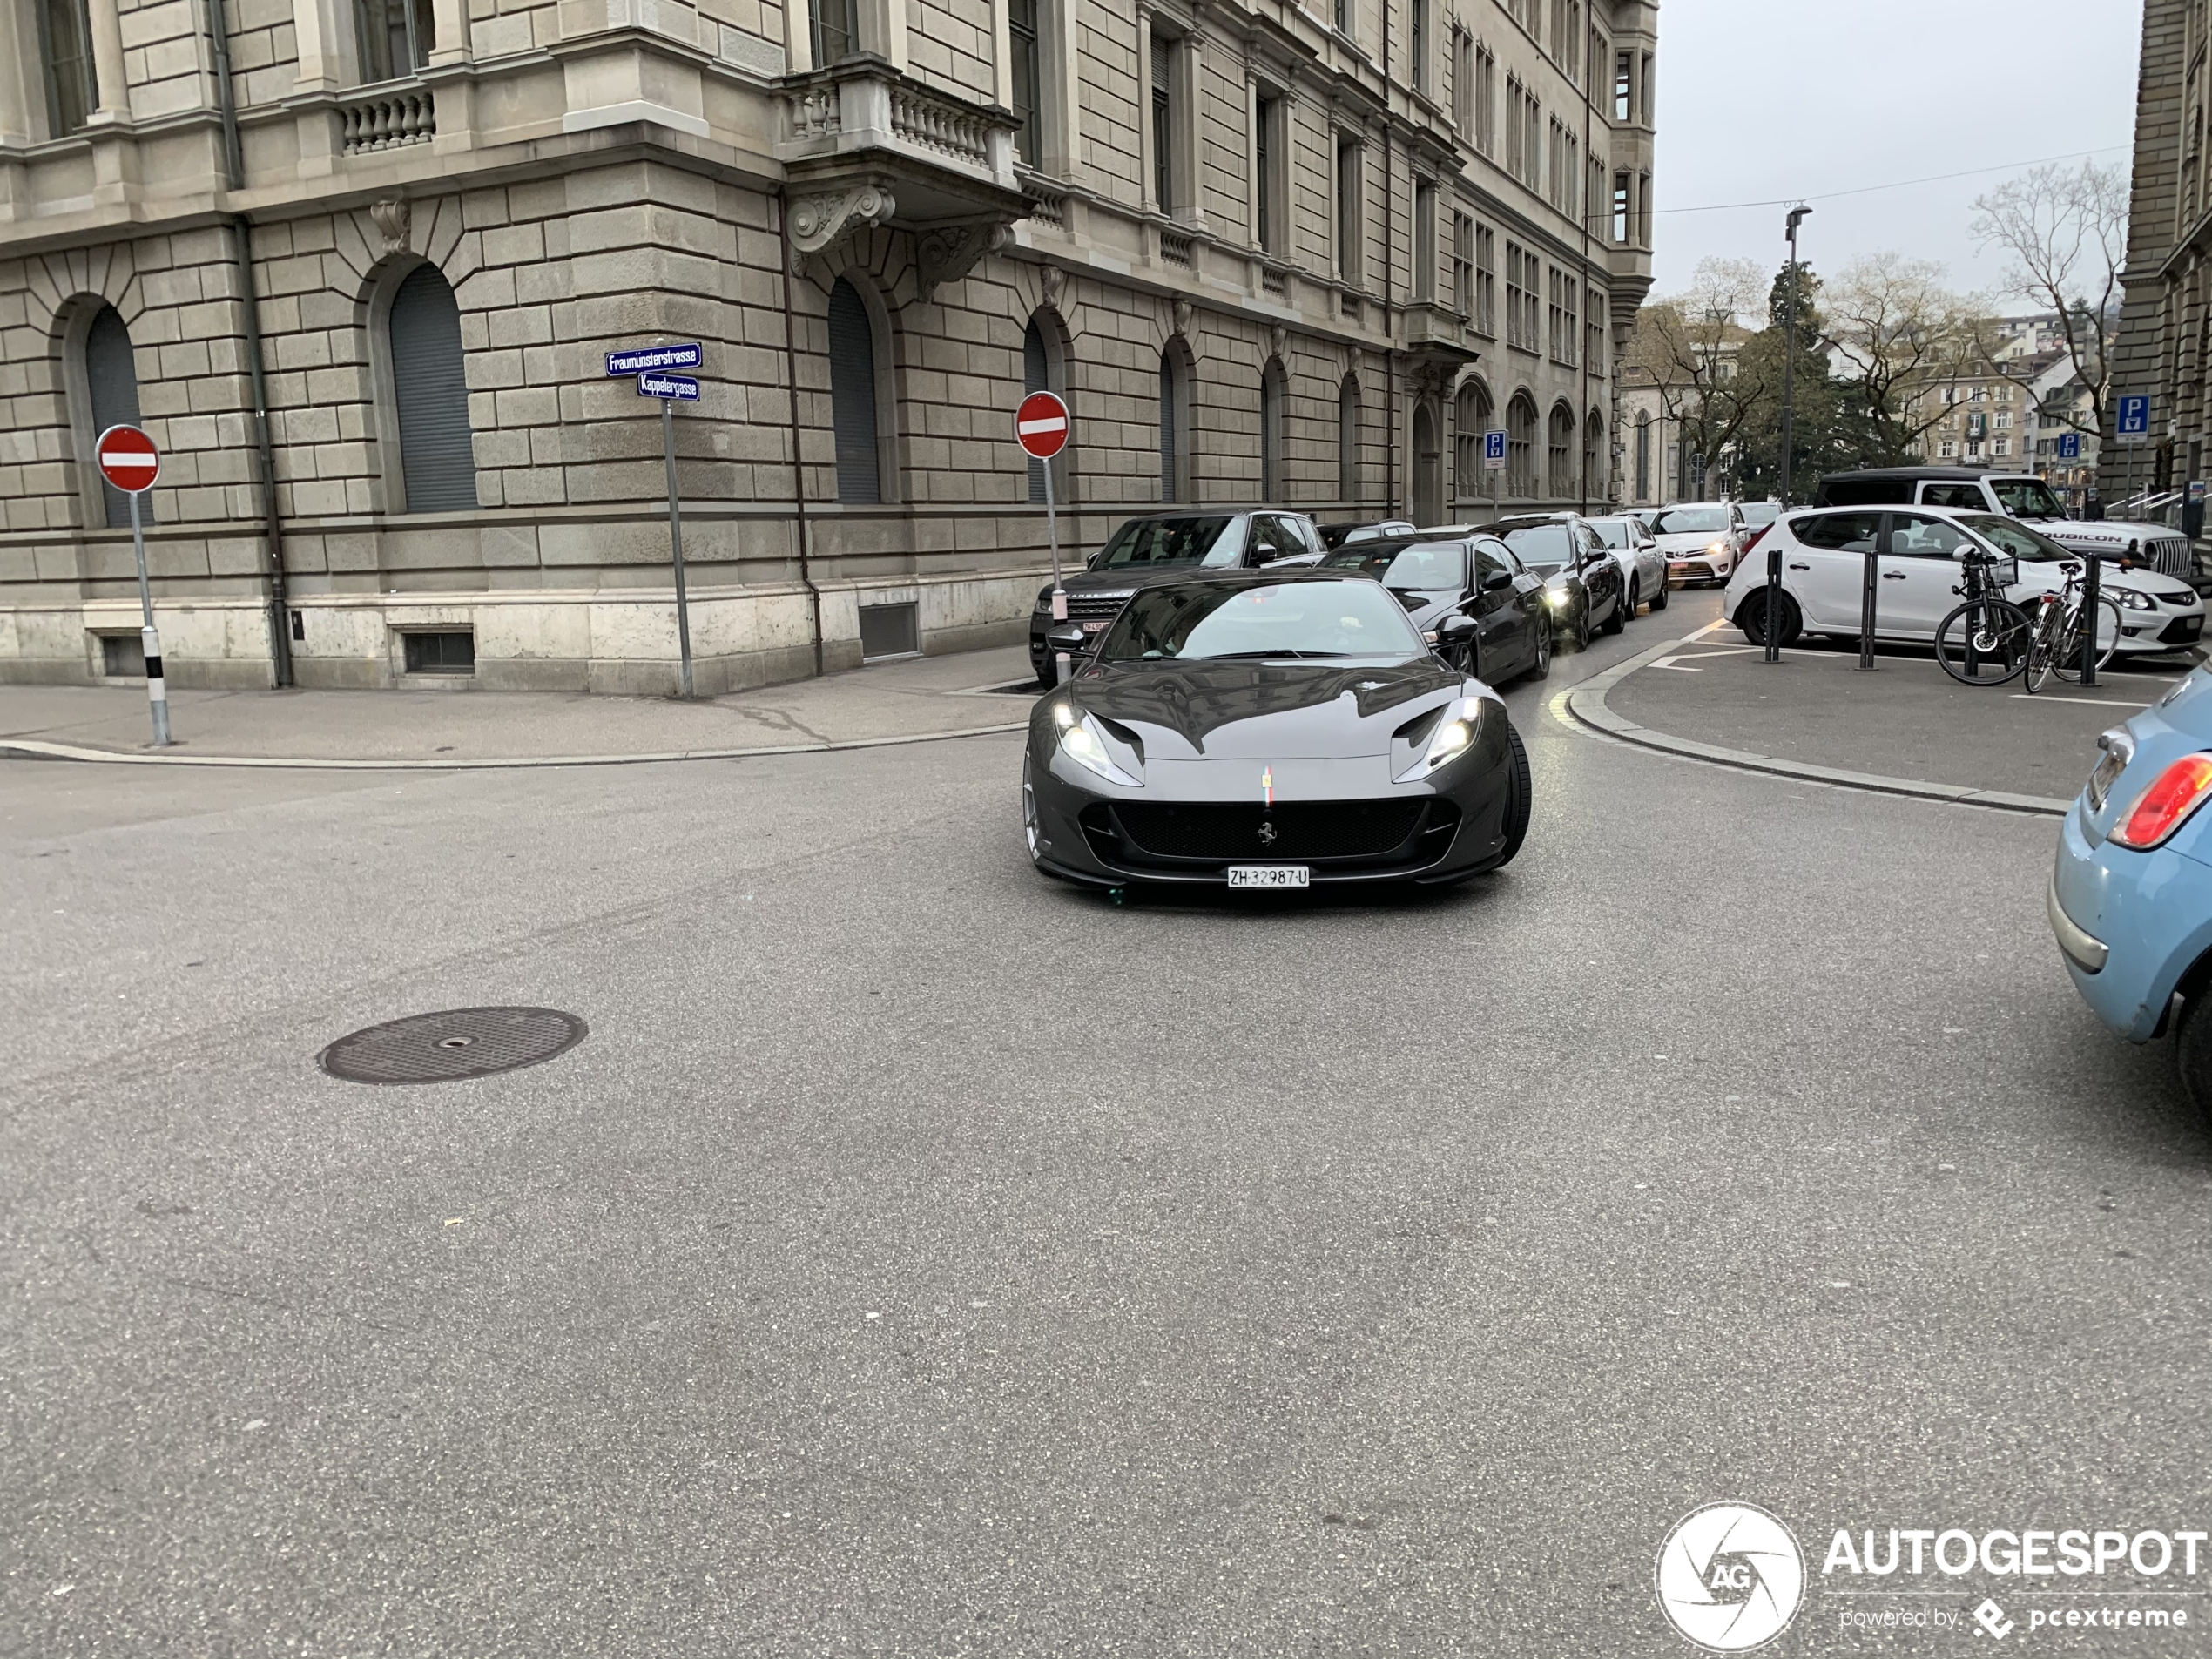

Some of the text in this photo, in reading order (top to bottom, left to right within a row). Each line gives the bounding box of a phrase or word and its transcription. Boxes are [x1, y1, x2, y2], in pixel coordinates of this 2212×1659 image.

[610, 350, 697, 371] Fraumünsterstrasse
[641, 374, 697, 397] Kappelergasse
[2128, 398, 2141, 417] P
[1491, 435, 1500, 448] P
[2065, 435, 2074, 448] P
[2039, 532, 2122, 543] RUBICON
